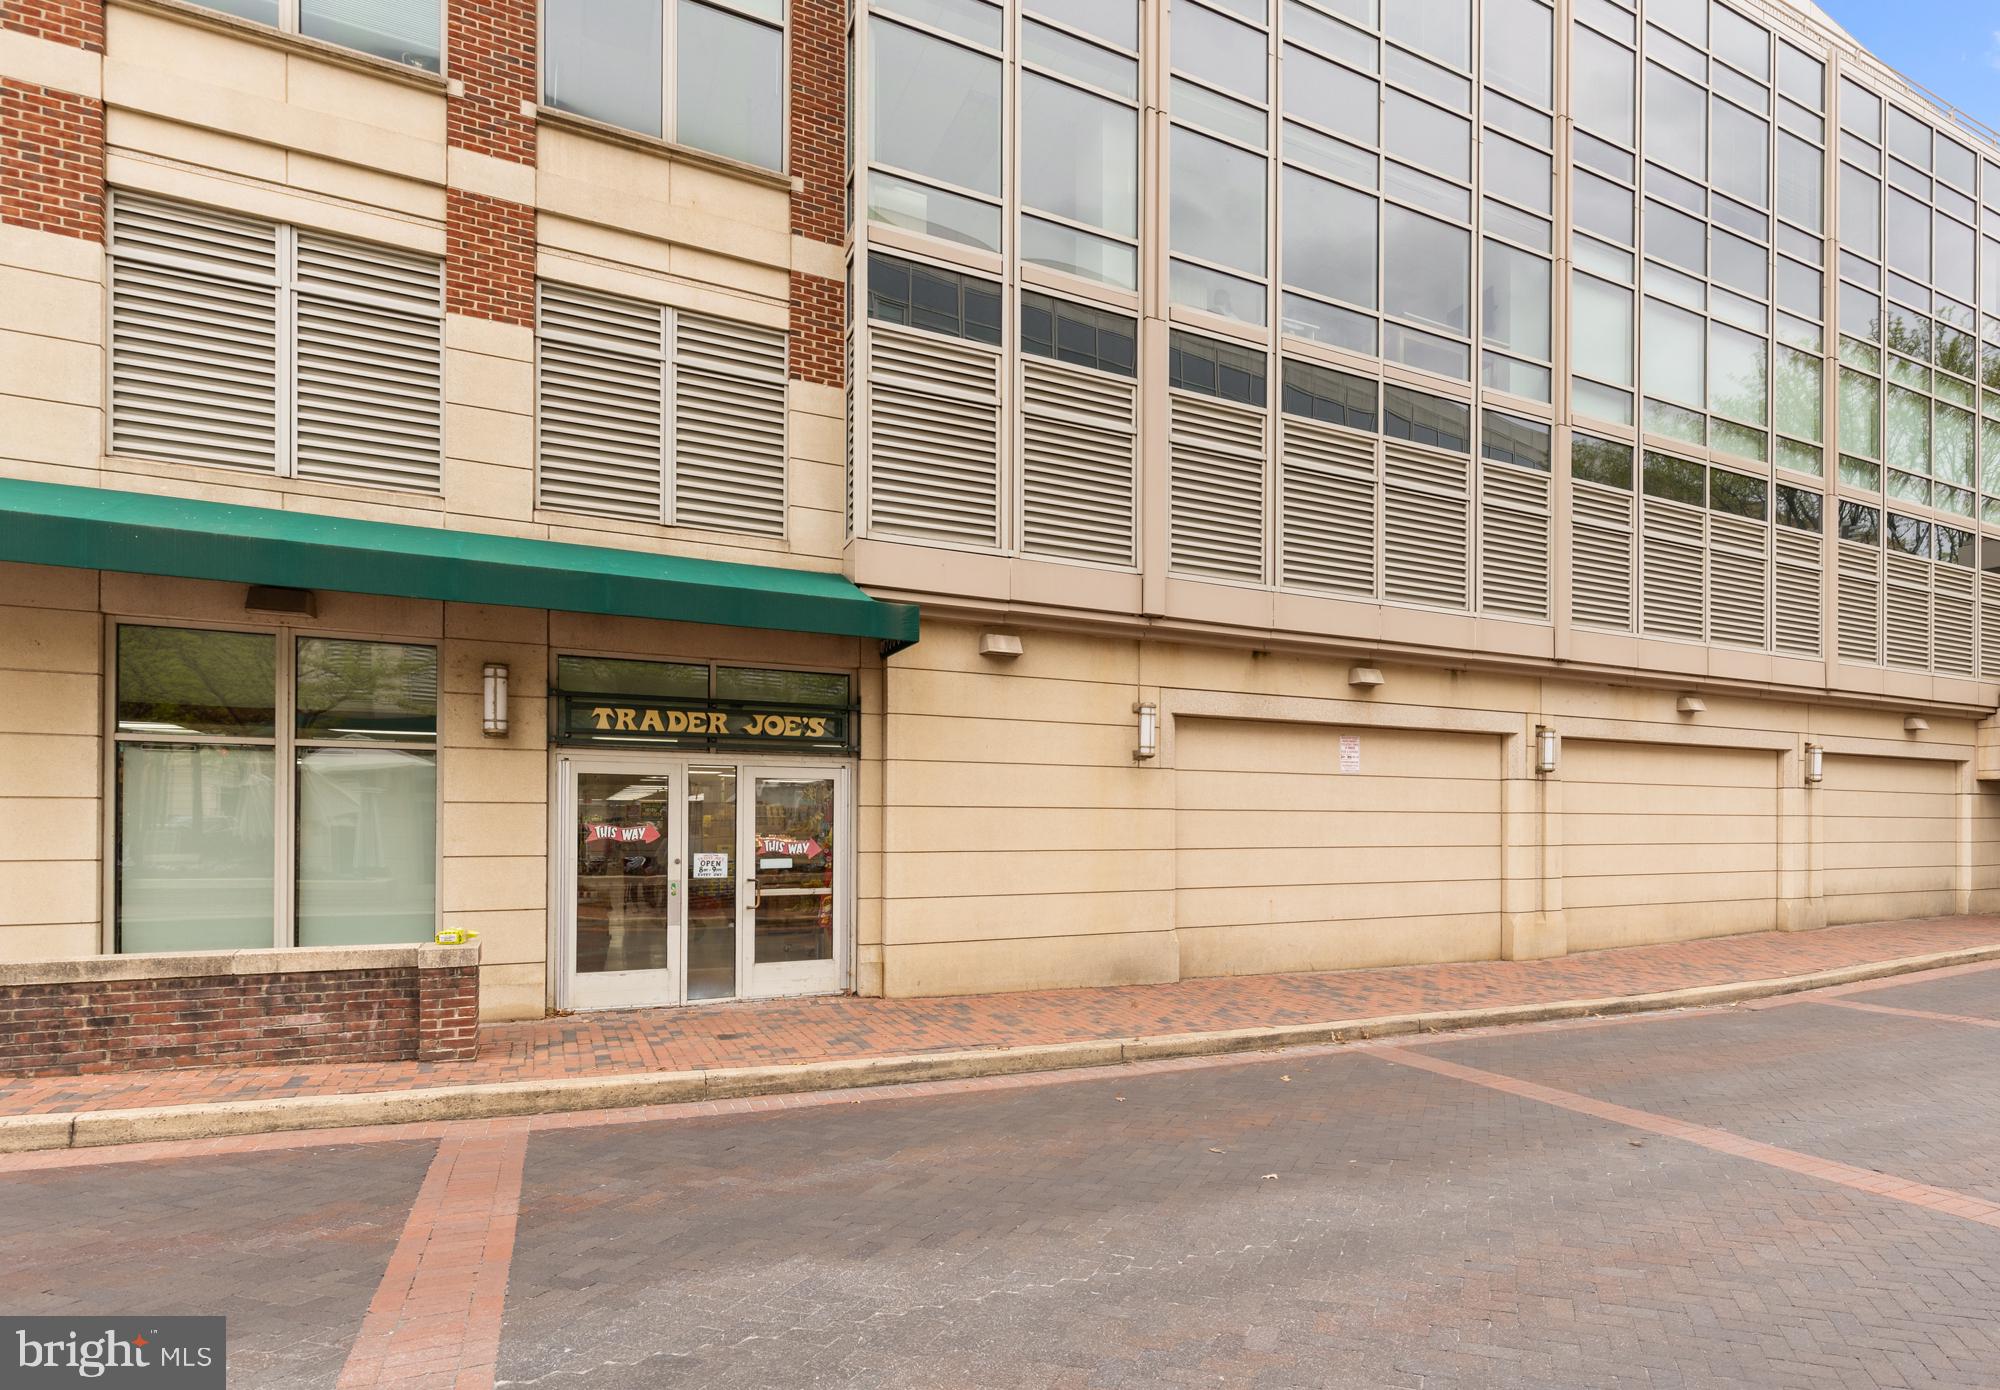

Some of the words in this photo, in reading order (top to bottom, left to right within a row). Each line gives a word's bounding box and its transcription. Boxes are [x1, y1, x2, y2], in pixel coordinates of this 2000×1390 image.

[591, 707, 730, 734] TRADER
[742, 714, 827, 737] JOE'S
[595, 825, 618, 839] THIS
[622, 827, 646, 840] WAY
[764, 840, 785, 852] THIS
[788, 842, 810, 854] WAY
